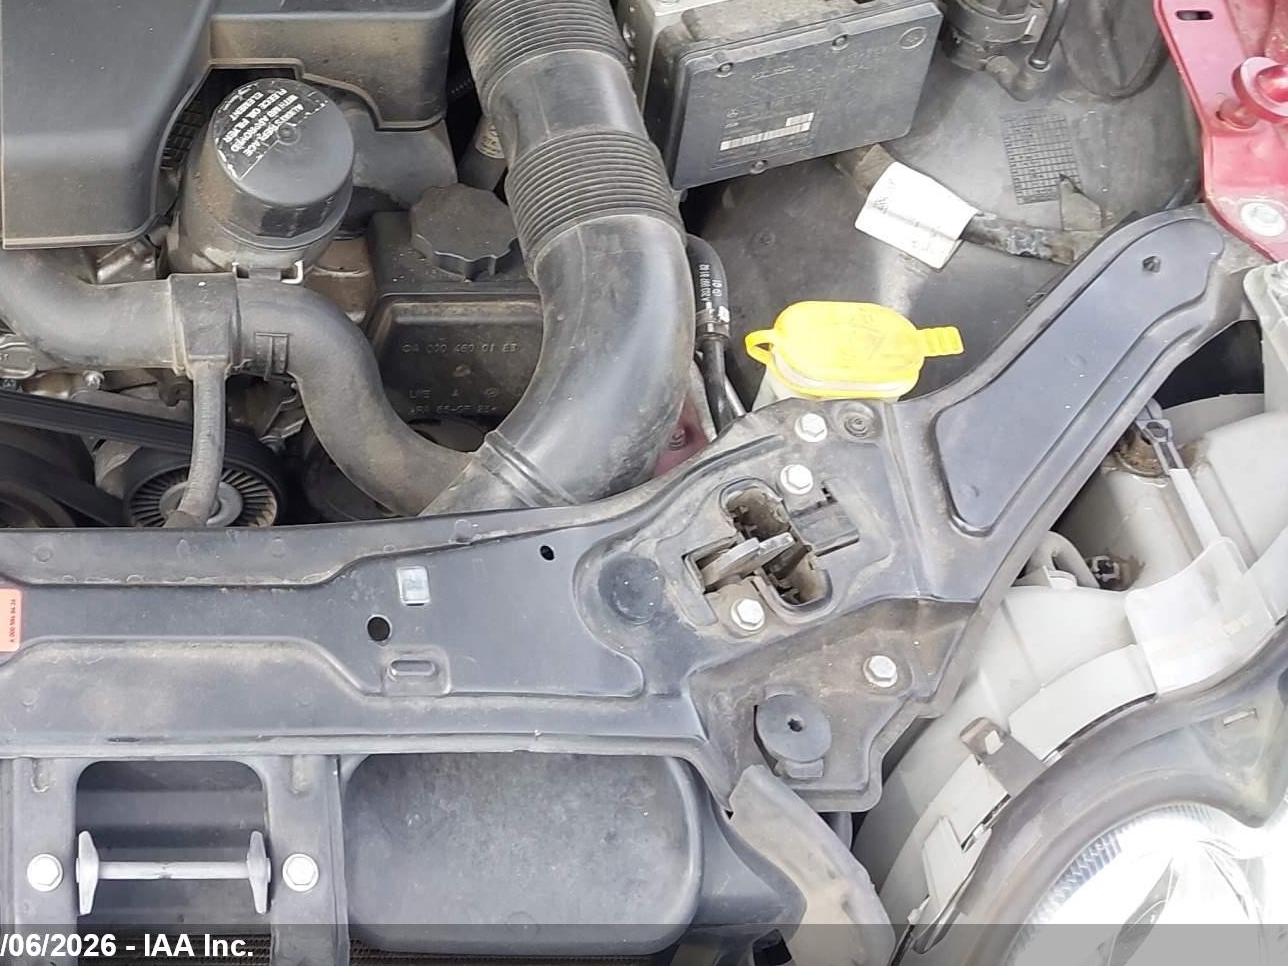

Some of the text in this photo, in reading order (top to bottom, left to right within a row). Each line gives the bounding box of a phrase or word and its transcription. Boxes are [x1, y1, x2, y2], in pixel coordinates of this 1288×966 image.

[228, 91, 264, 121] ELEMENT
[257, 88, 288, 110] FLEECE
[230, 114, 269, 152] APPROVED
